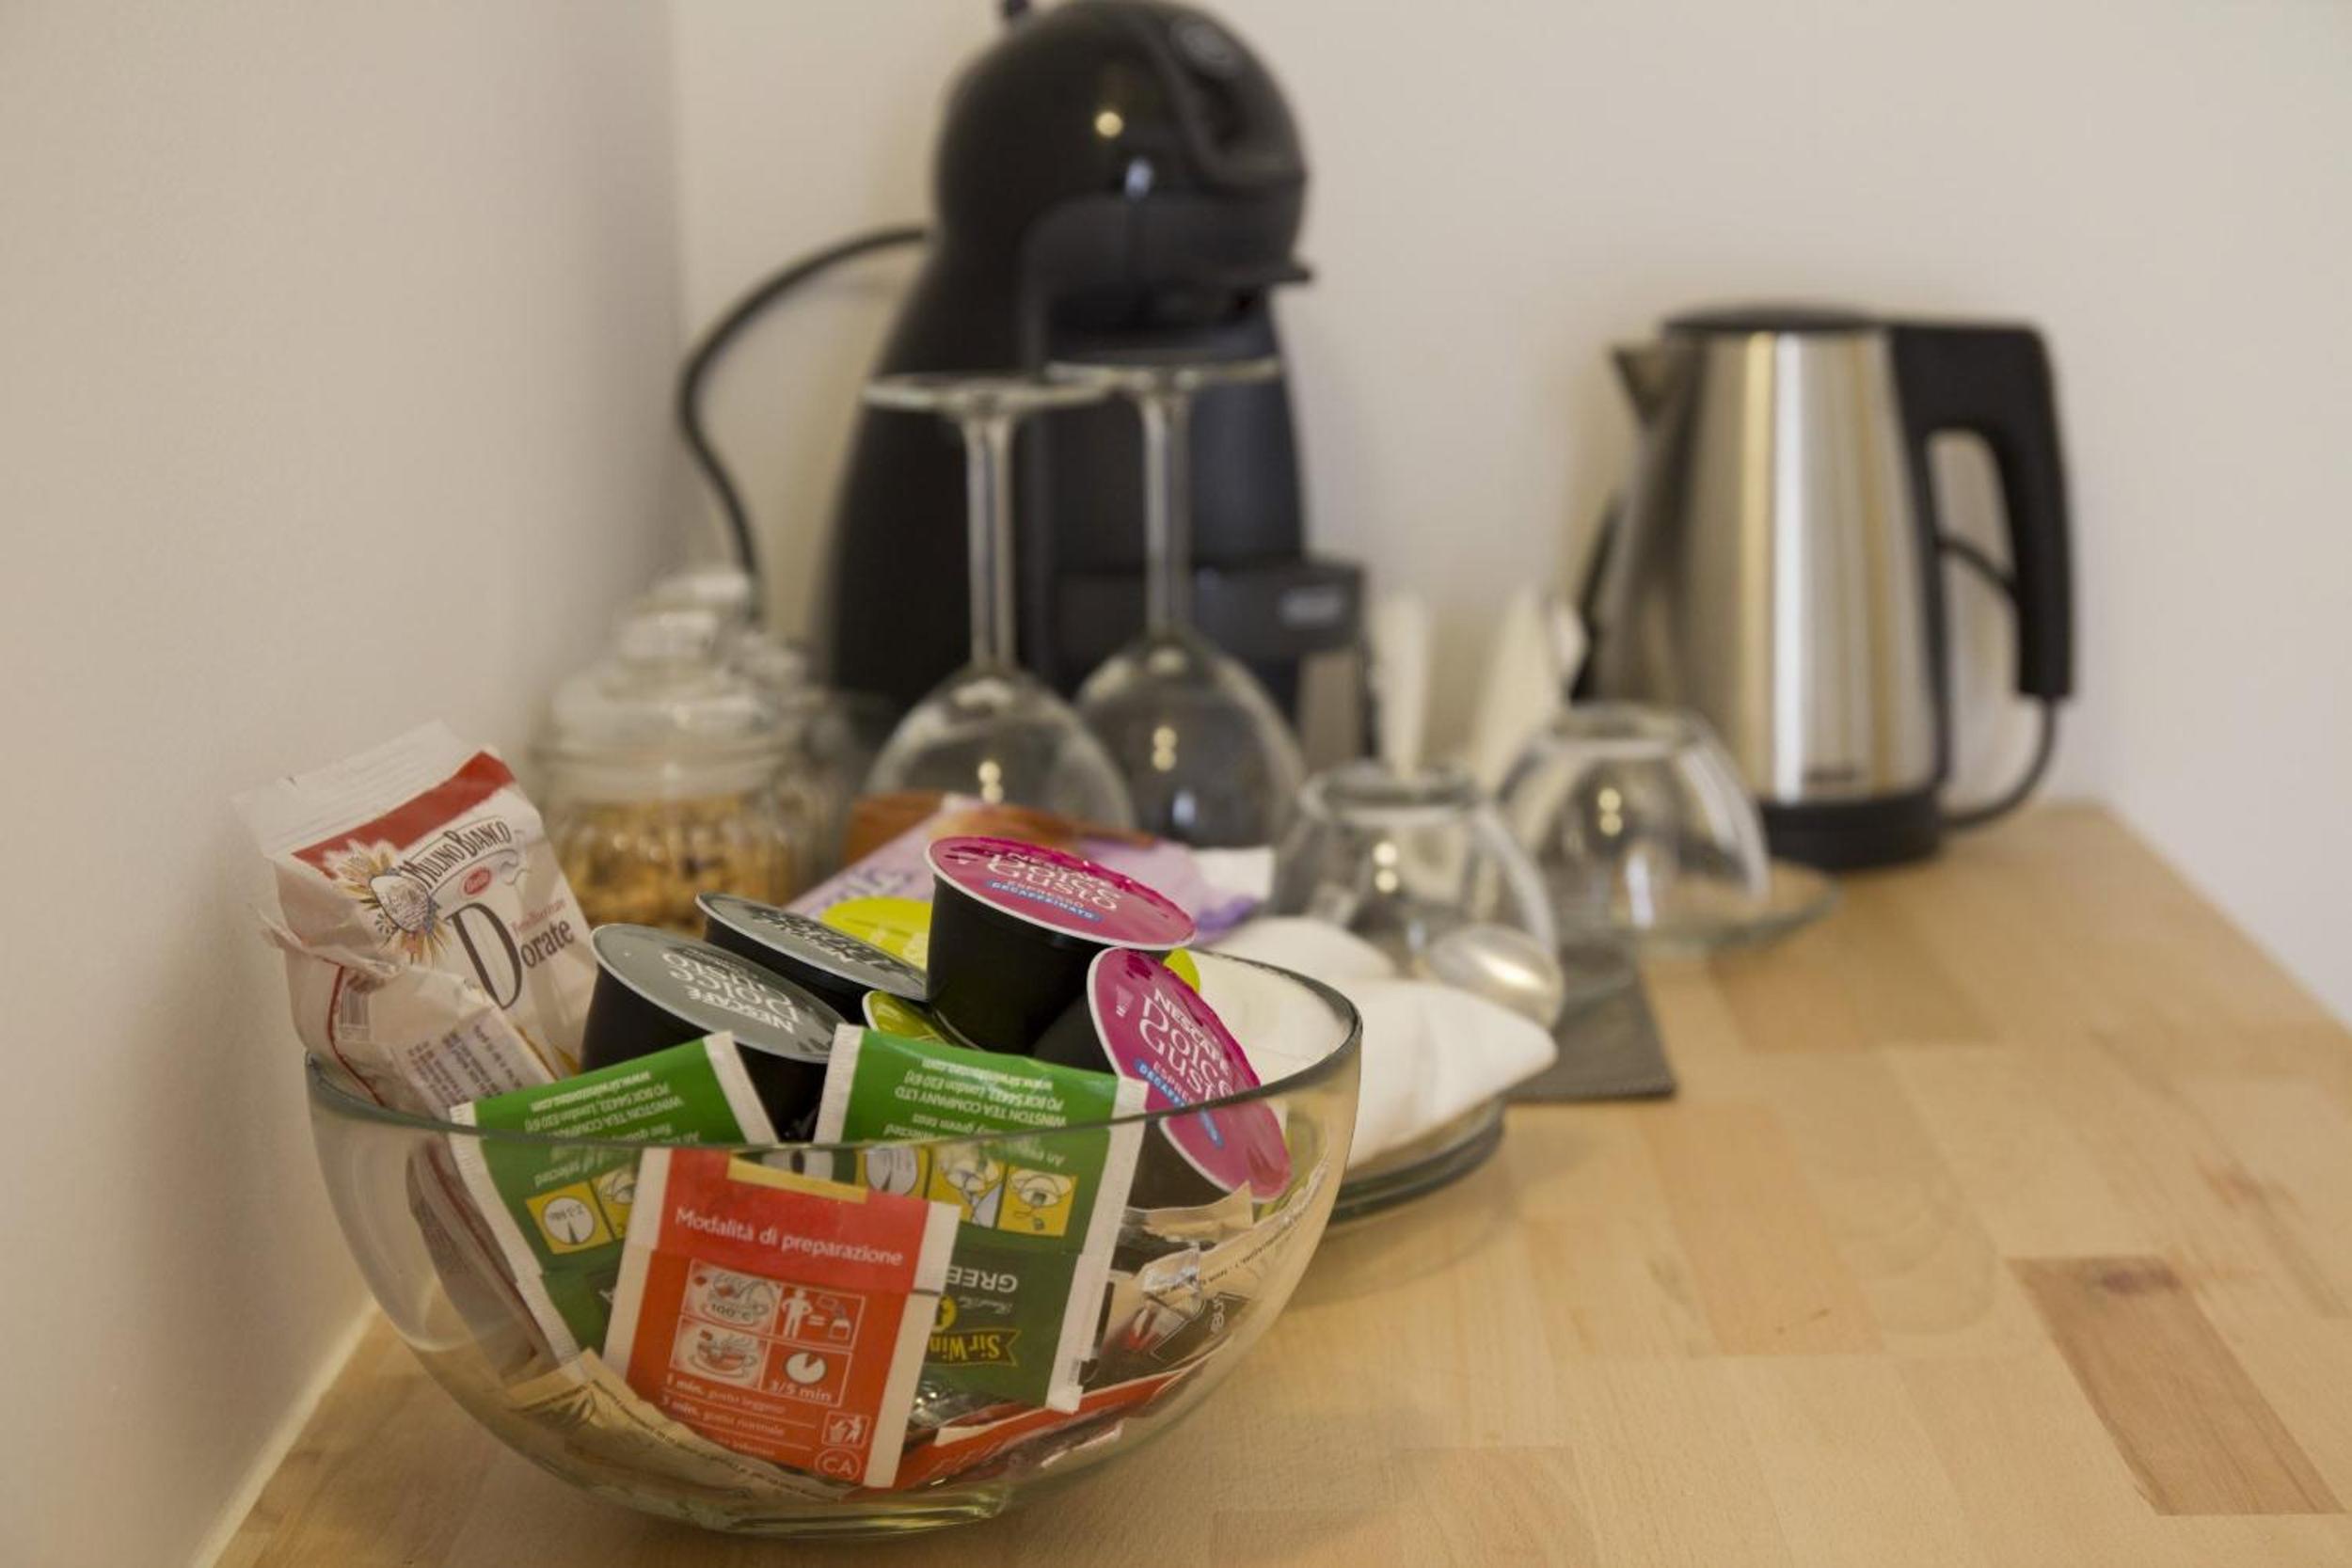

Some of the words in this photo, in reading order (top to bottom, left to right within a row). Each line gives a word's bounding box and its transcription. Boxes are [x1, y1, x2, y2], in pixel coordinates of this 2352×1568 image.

[444, 820, 512, 859] BIANCO
[991, 881, 1094, 920] DECAFFEINATO
[446, 902, 575, 1010] Dorate
[895, 1085, 918, 1101] LTD
[918, 1092, 982, 1115] COMPANY
[983, 1104, 1007, 1120] TEA
[1009, 1109, 1067, 1128] WINSTON
[675, 1206, 755, 1243] Modalità
[759, 1227, 779, 1244] di
[781, 1233, 904, 1267] preparazione
[946, 1266, 1019, 1293] GREE
[929, 1335, 969, 1361] Win
[967, 1333, 1001, 1359] Sir
[799, 1387, 832, 1402] min
[821, 1458, 853, 1477] CA
